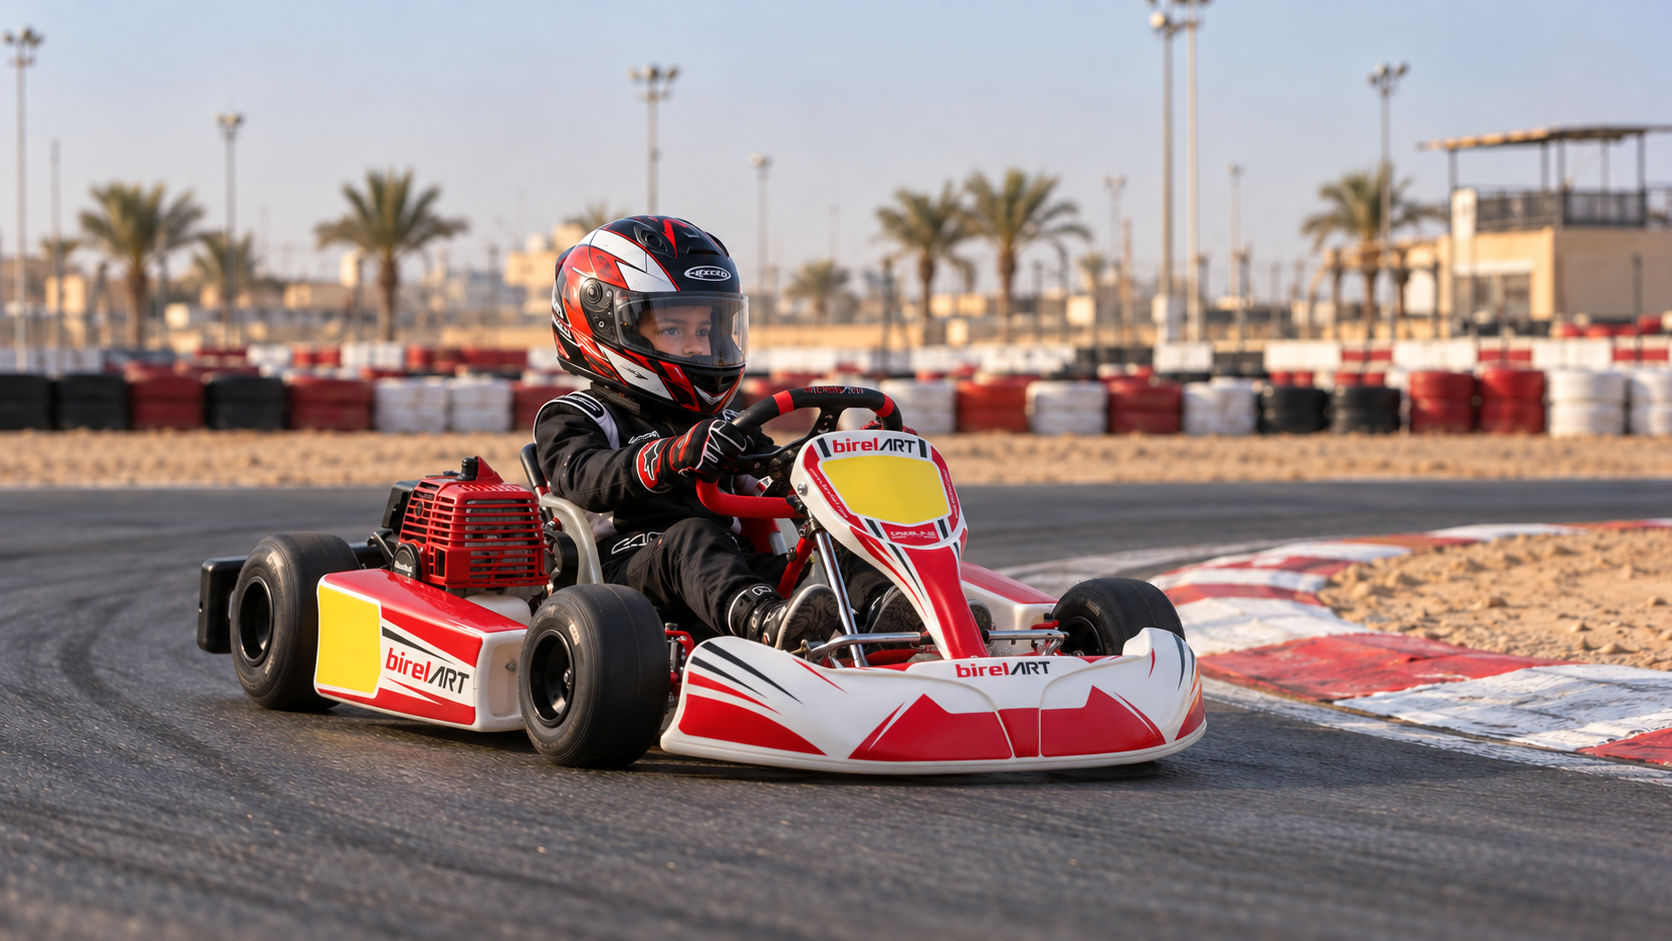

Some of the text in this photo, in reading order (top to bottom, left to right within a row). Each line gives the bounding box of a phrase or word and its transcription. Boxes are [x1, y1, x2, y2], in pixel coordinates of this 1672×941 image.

[832, 437, 917, 453] birelART
[385, 647, 470, 694] birelART
[955, 661, 1050, 678] birelART
